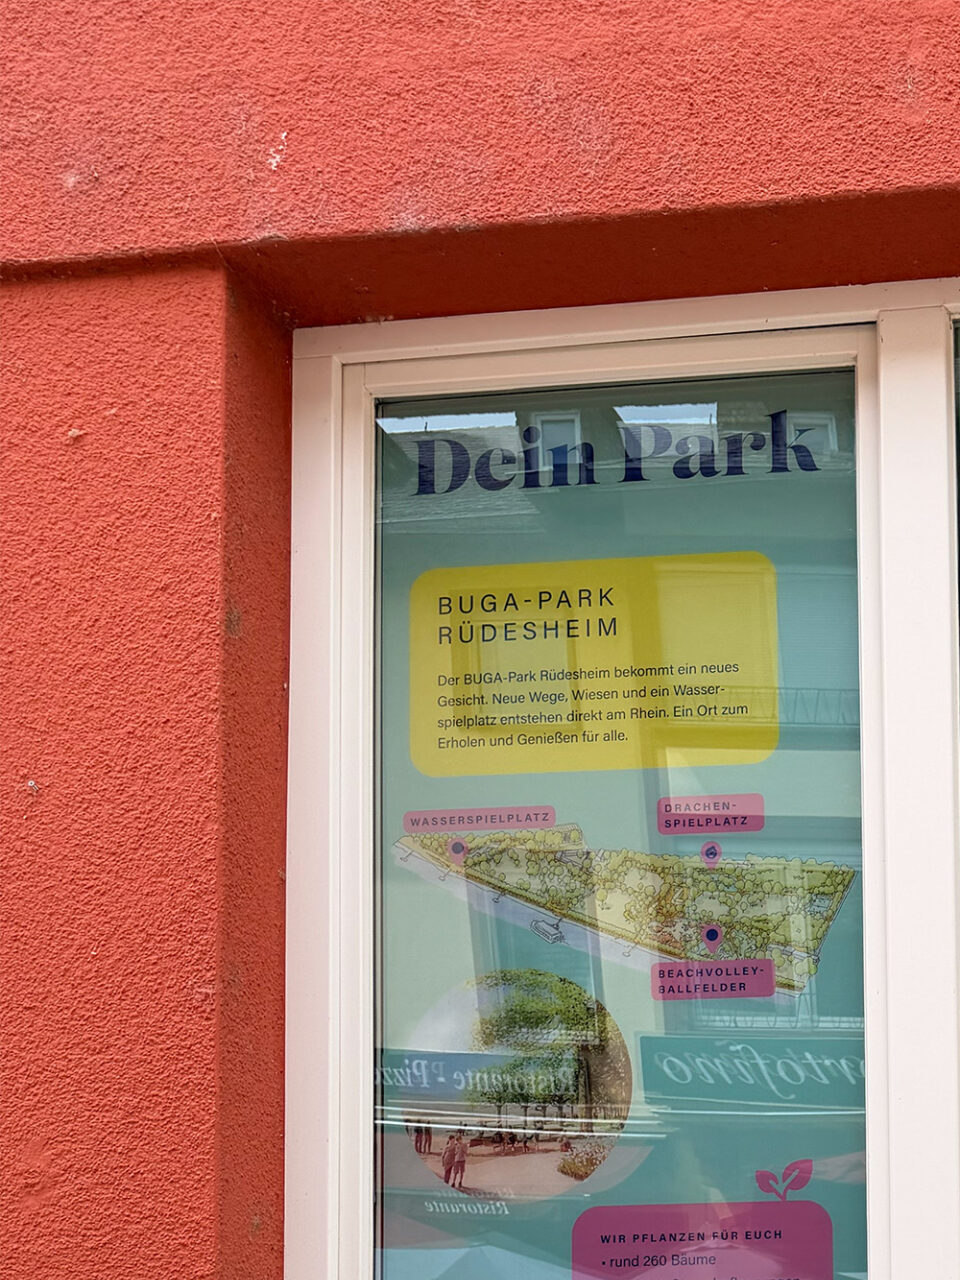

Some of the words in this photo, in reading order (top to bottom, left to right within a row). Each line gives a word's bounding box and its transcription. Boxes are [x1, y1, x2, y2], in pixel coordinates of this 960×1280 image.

[411, 426, 600, 496] Dein
[619, 410, 821, 482] Park
[438, 587, 615, 615] BUGA-PARK
[438, 617, 618, 644] RÜDESHEIM
[438, 675, 460, 686] Der
[464, 671, 536, 685] BUGA-Park
[540, 668, 610, 681] Rüdesheim
[614, 665, 674, 678] bekommt
[678, 663, 696, 674] ein
[701, 663, 739, 674] neues
[438, 694, 488, 707] Gesicht.
[492, 693, 525, 704] Neue
[529, 692, 568, 705] Wege,
[572, 689, 618, 700] Wiesen
[623, 686, 646, 699] und
[650, 687, 669, 697] ein
[674, 684, 725, 696] Wasser-
[438, 715, 496, 730] spielplatz
[500, 712, 562, 725] entstehen
[567, 710, 602, 722] direkt
[606, 710, 625, 720] am
[630, 707, 669, 719] Rhein.
[673, 706, 692, 717] Ein
[697, 705, 718, 716] Ort
[721, 705, 748, 715] zum
[438, 737, 485, 749] Erholen
[490, 735, 513, 746] und
[517, 732, 578, 745] Genießen
[582, 731, 599, 742] für
[603, 730, 628, 742] alle.
[664, 801, 736, 813] DRACHEN-
[410, 813, 549, 827] WASSERSPIELPLATZ
[664, 816, 748, 828] SPIELPLATZ
[658, 966, 764, 979] BEACHVOLLEY-
[658, 982, 746, 994] BALLFELDER
[601, 1234, 626, 1244] WIR
[633, 1232, 705, 1243] PFLANZEN
[712, 1230, 738, 1240] FÜR
[745, 1230, 782, 1239] EUCH
[610, 1255, 639, 1267] rund
[643, 1255, 666, 1266] 260
[671, 1252, 716, 1266] Bäume
